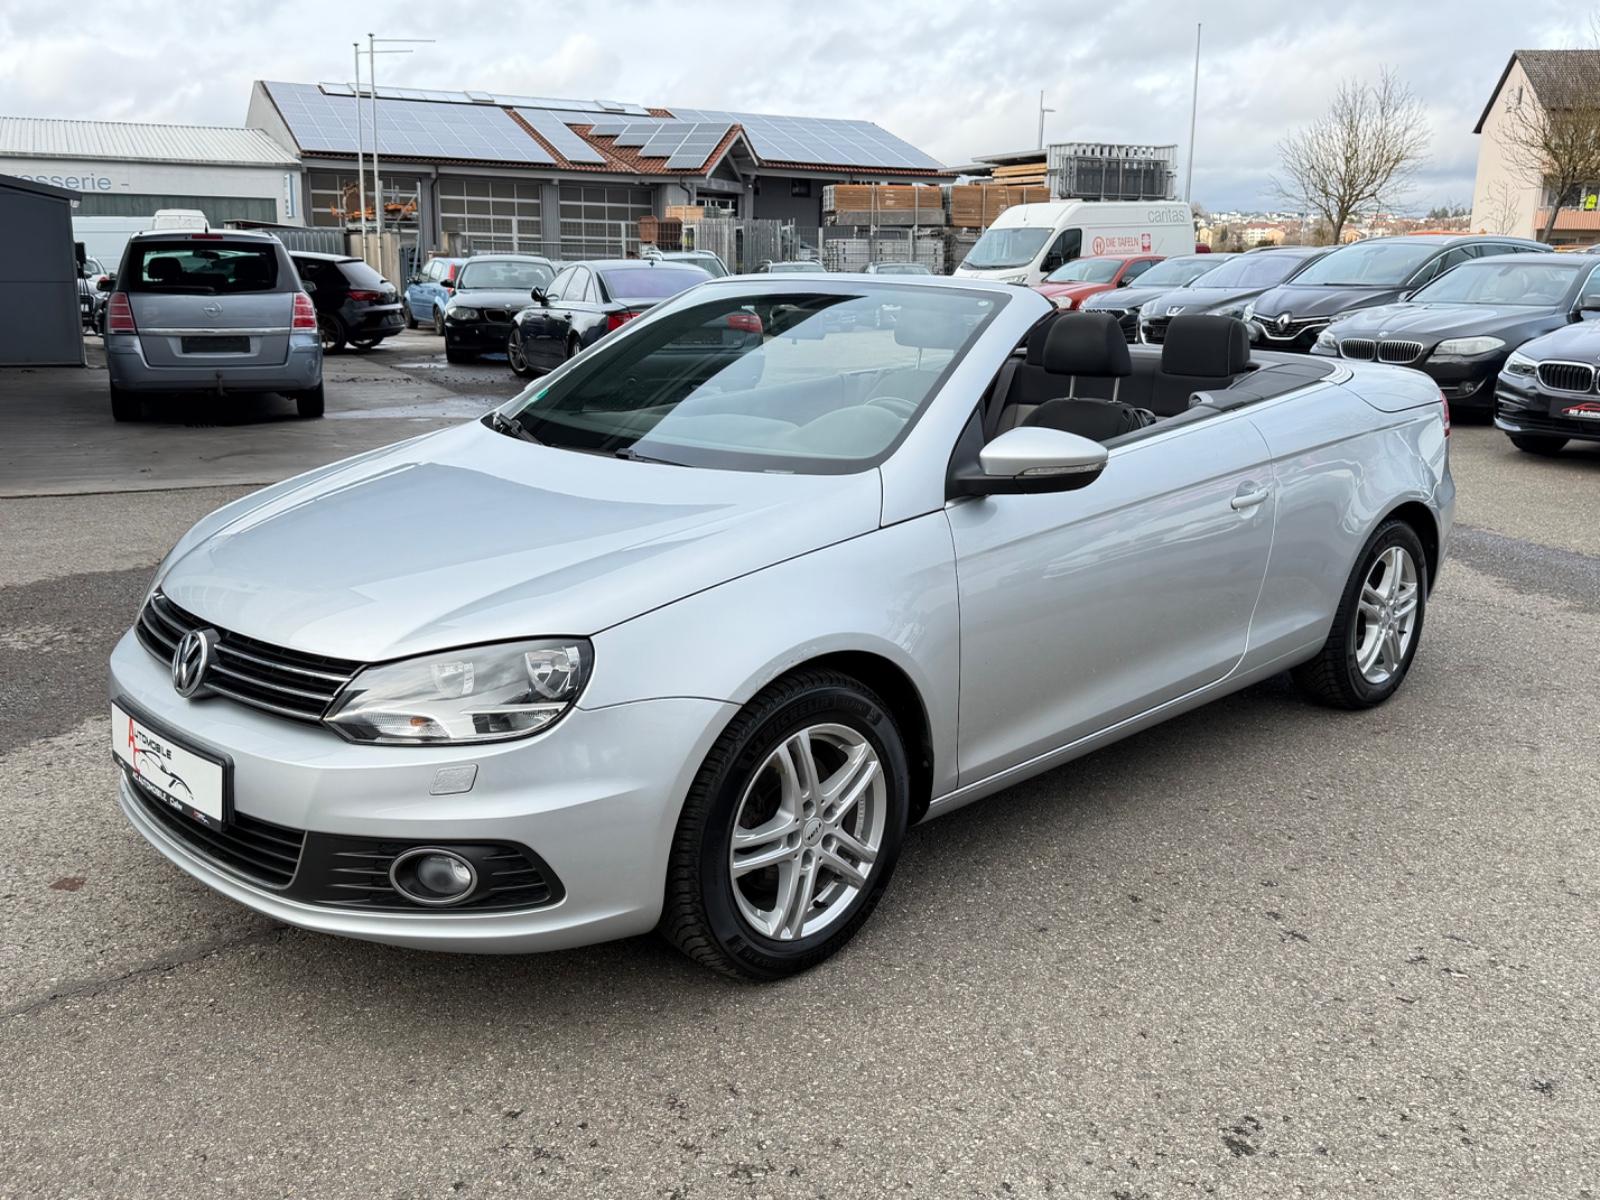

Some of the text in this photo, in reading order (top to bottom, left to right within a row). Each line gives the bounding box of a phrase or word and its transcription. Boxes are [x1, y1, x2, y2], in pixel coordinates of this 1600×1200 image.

[1147, 207, 1185, 223] caritas
[1105, 236, 1139, 248] DIE TAFELN
